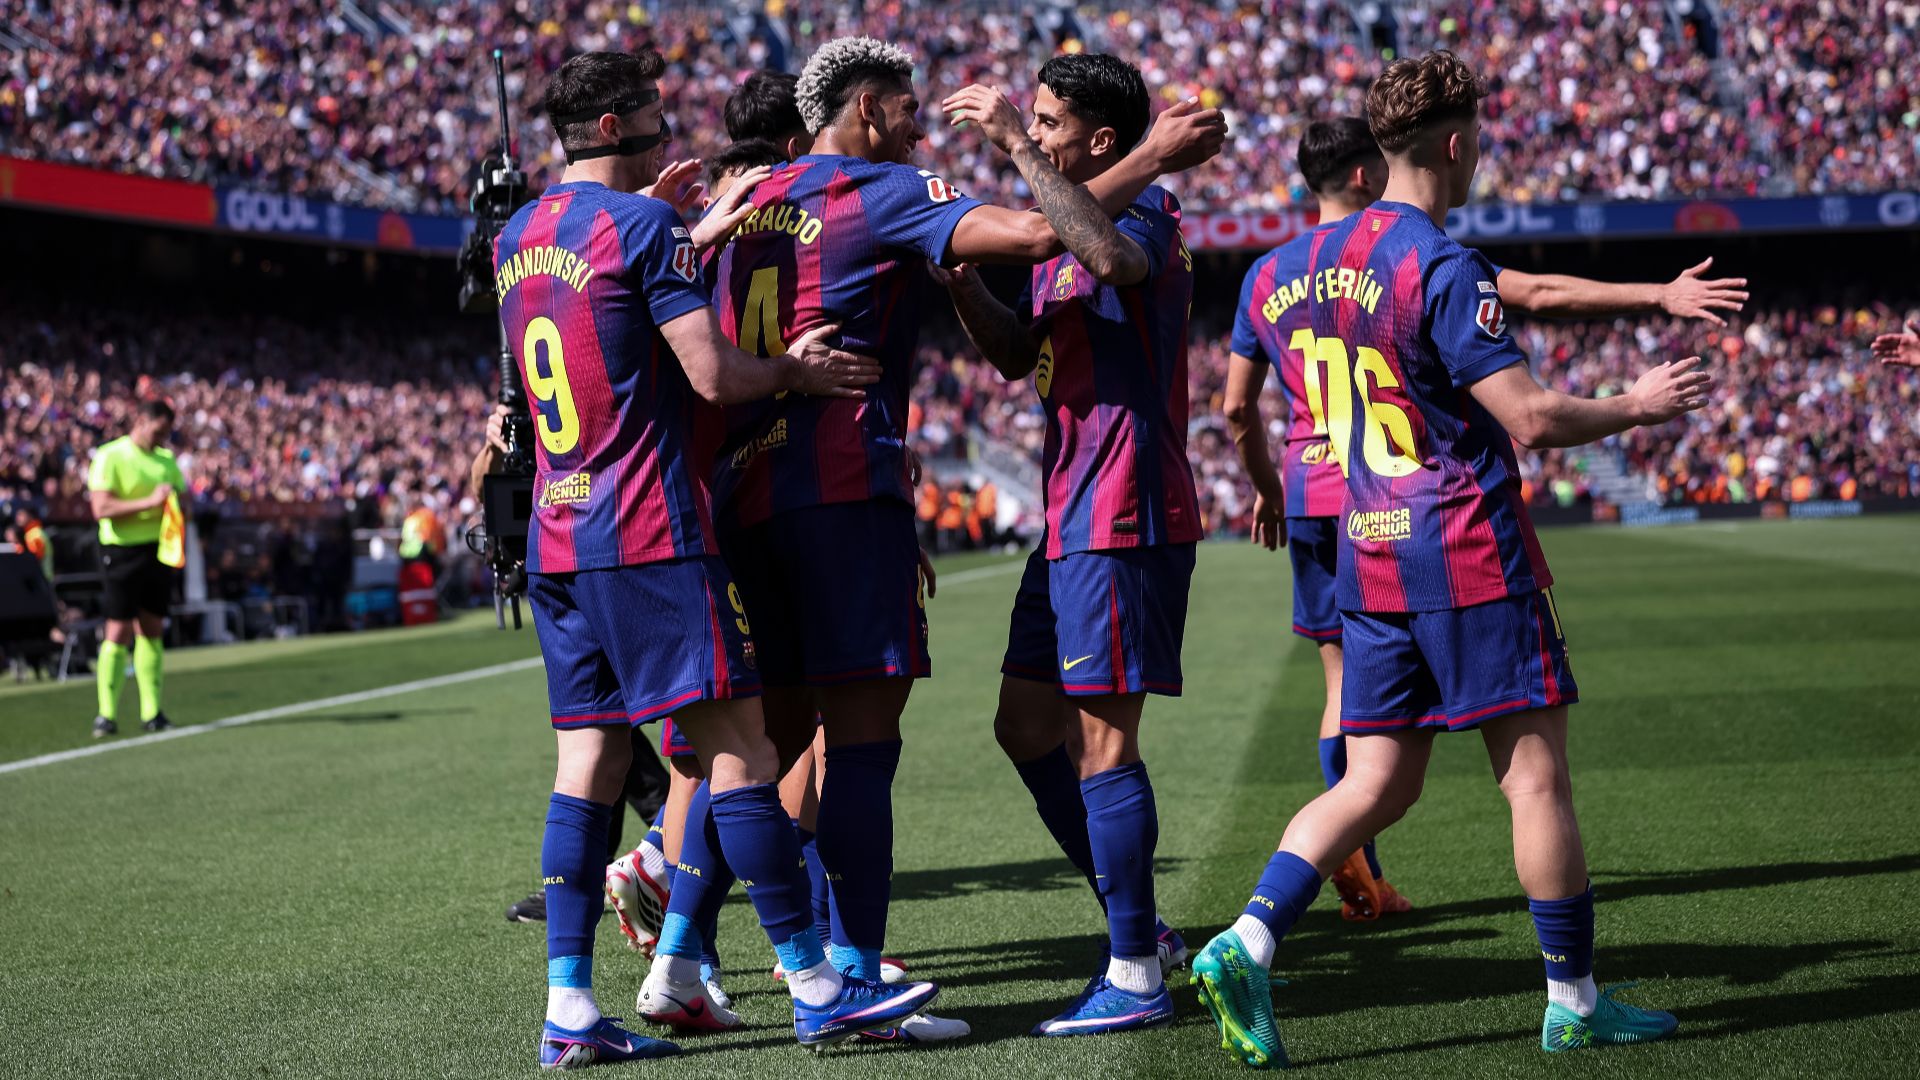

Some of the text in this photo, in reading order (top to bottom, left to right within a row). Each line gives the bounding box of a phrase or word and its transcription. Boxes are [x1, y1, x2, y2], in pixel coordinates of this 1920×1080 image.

[1262, 274, 1311, 324] GERA
[523, 316, 580, 455] 9
[1314, 337, 1423, 479] 16
[1362, 508, 1410, 525] UNHCR
[1365, 521, 1411, 537] ACNUR
[727, 582, 750, 635] 9
